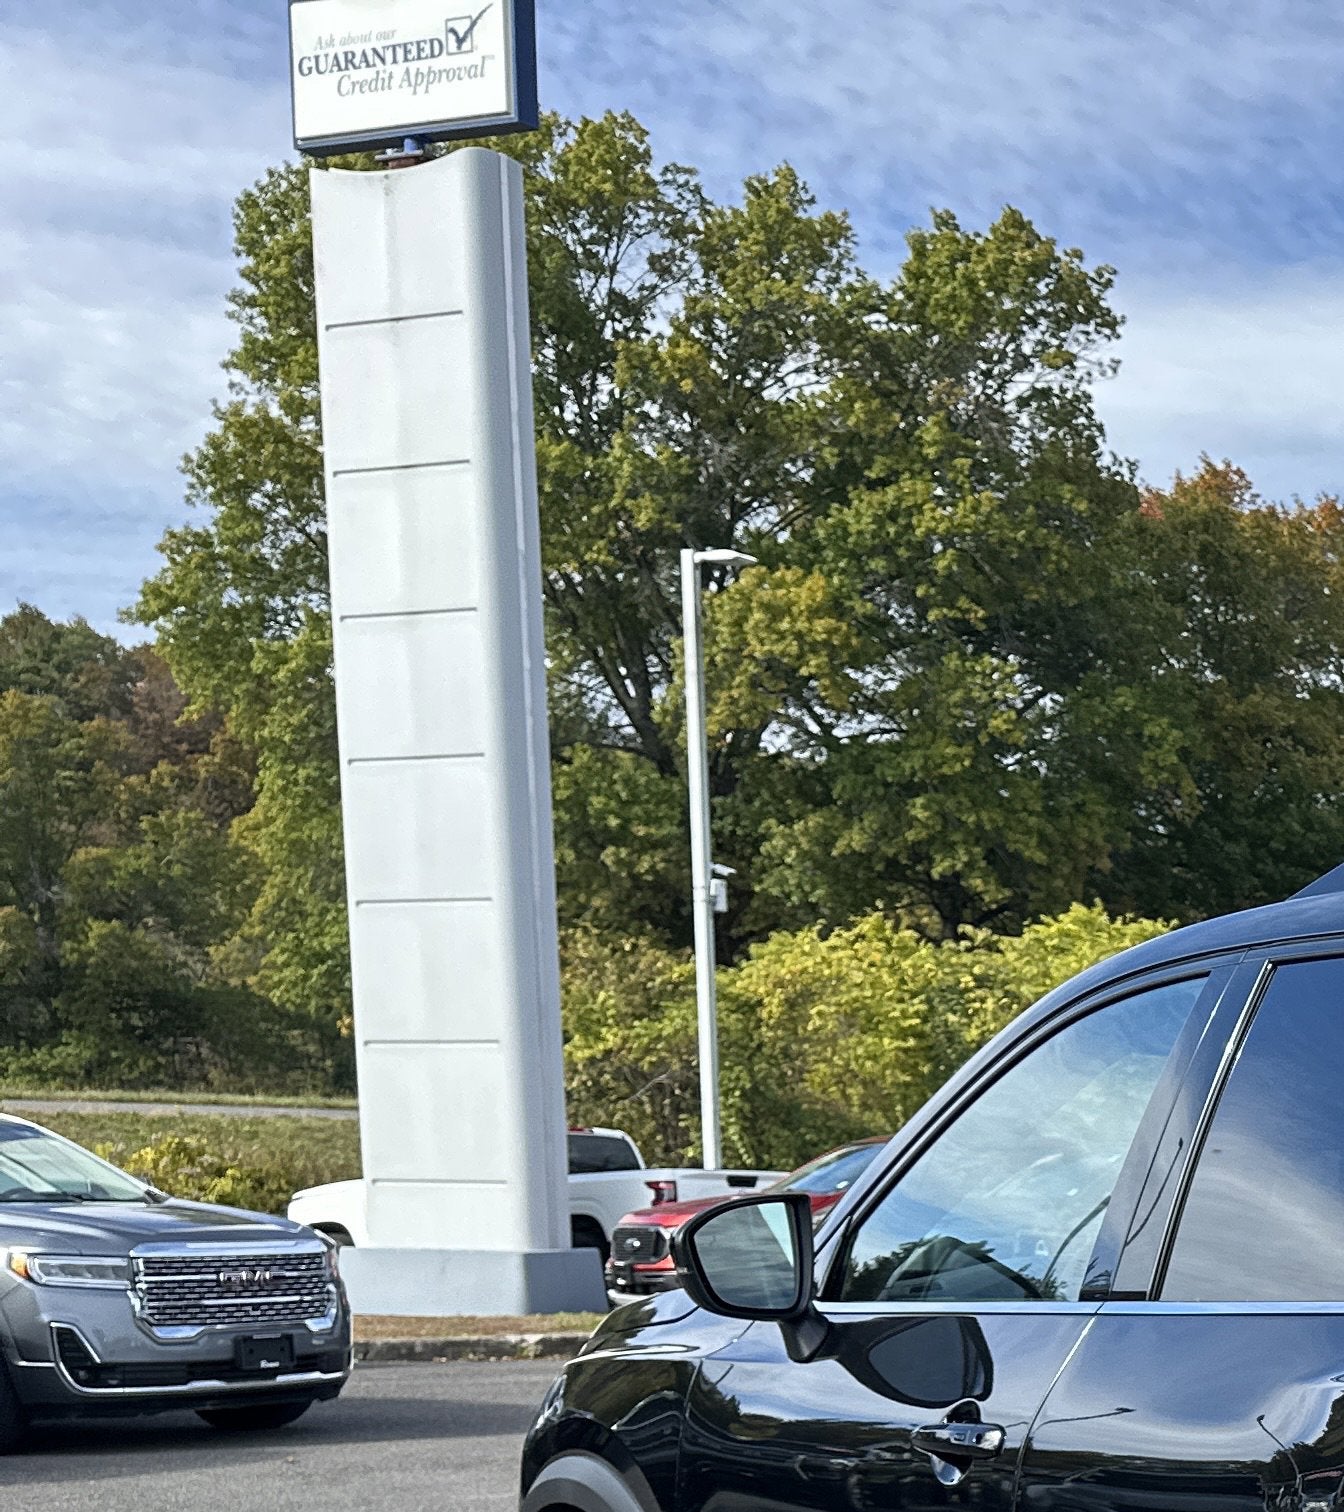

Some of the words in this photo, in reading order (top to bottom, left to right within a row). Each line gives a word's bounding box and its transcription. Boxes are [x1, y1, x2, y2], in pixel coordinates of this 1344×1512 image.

[297, 37, 445, 78] GUARANTEED
[314, 34, 336, 51] Ask
[339, 29, 372, 46] about
[375, 28, 397, 42] our
[336, 69, 394, 98] Credit
[398, 55, 486, 96] Approval
